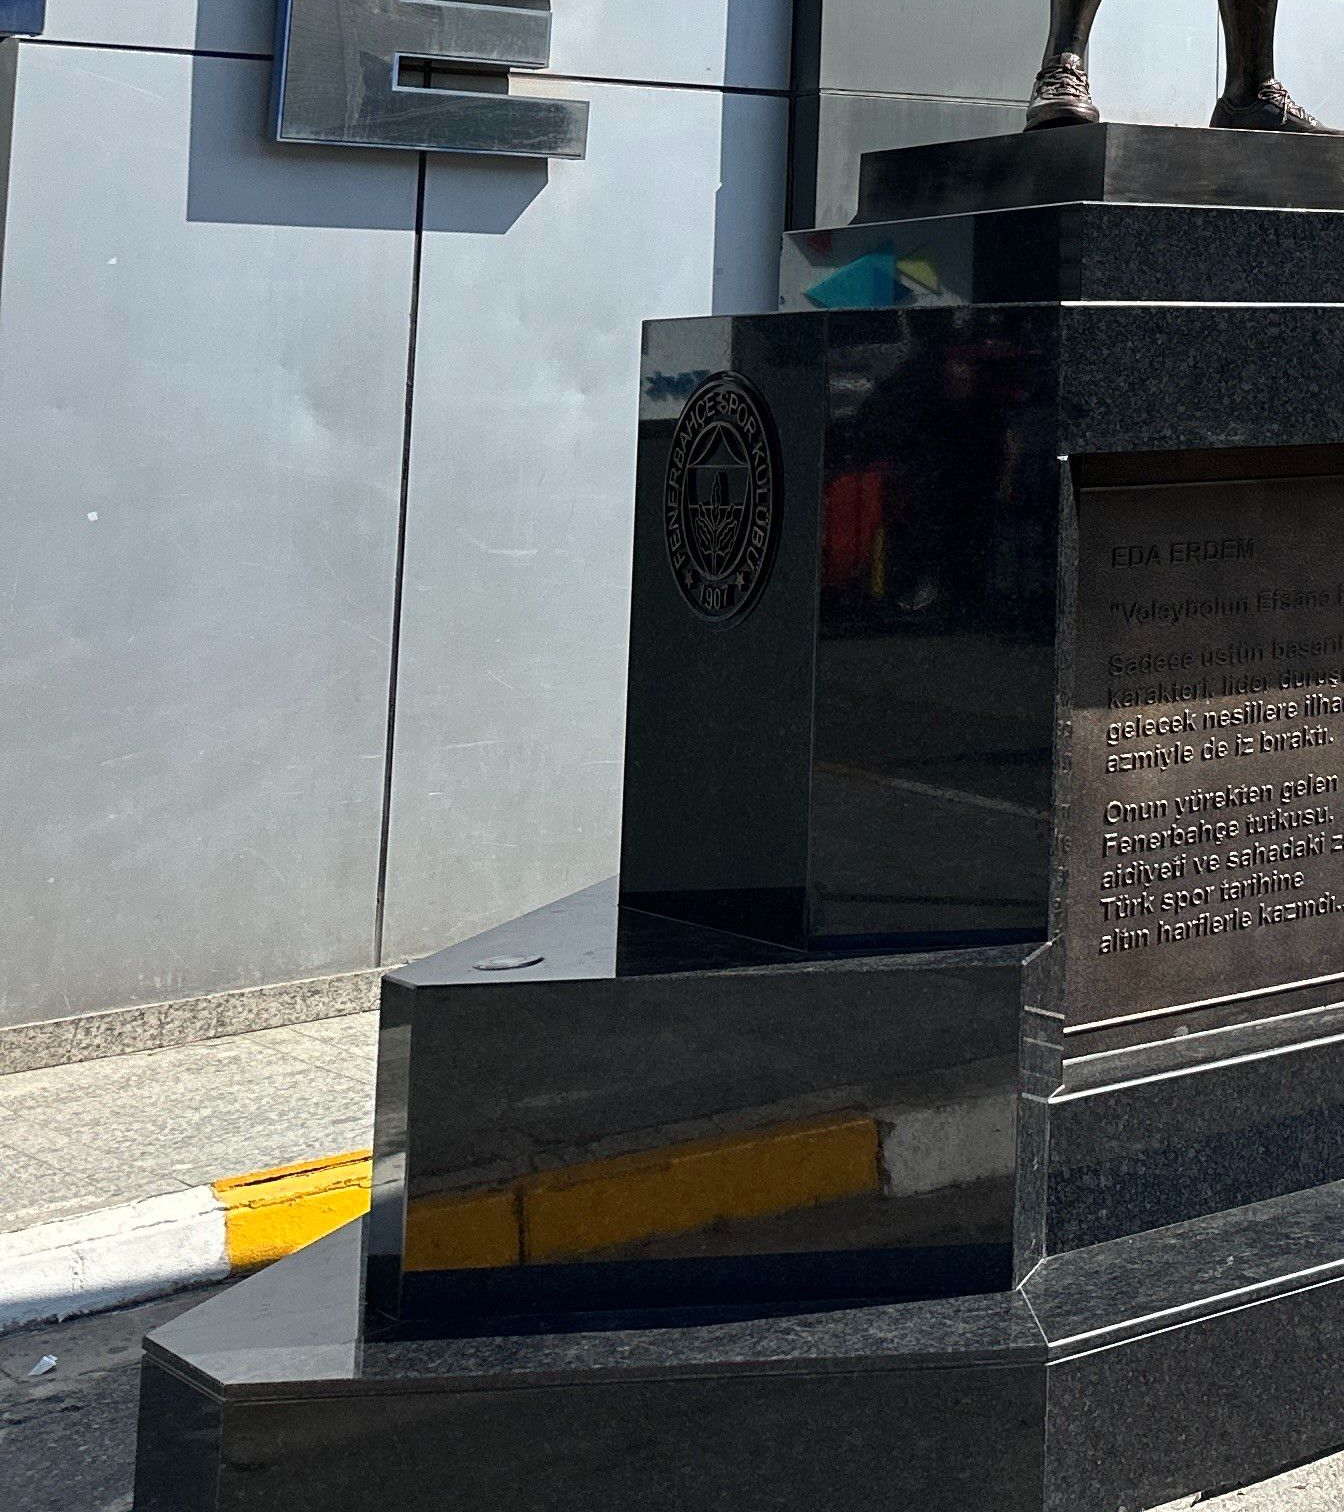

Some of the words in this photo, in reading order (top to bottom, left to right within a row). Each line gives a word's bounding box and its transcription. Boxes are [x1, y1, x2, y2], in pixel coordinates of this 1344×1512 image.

[667, 394, 715, 570] FENERBAHÇE
[717, 390, 757, 440] SPOR
[1111, 544, 1161, 569] EDA
[1169, 538, 1255, 564] ERDEM
[698, 583, 728, 610] 1907
[1107, 652, 1195, 677] Sadece
[1201, 643, 1264, 666] üstün
[1222, 675, 1271, 696] lider
[1106, 710, 1196, 747] gelecek
[1203, 700, 1299, 731] nesillere
[1106, 741, 1195, 774] azmiyle
[1201, 736, 1229, 761] de
[1235, 732, 1255, 756] iz
[1260, 724, 1335, 754] bıraktı.
[1103, 800, 1167, 825] Onun
[1174, 785, 1274, 820] yürekten
[1280, 772, 1340, 801] gelen
[1101, 820, 1240, 858] Fenerbahçe
[1101, 855, 1187, 891] aidiyeti
[1193, 852, 1221, 874] ve
[1226, 832, 1327, 867] sahadaki
[1099, 892, 1156, 922] Türk
[1160, 884, 1215, 913] spor
[1220, 869, 1305, 900] tarihine
[1098, 926, 1150, 955] altın
[1157, 908, 1254, 945] harflerle
